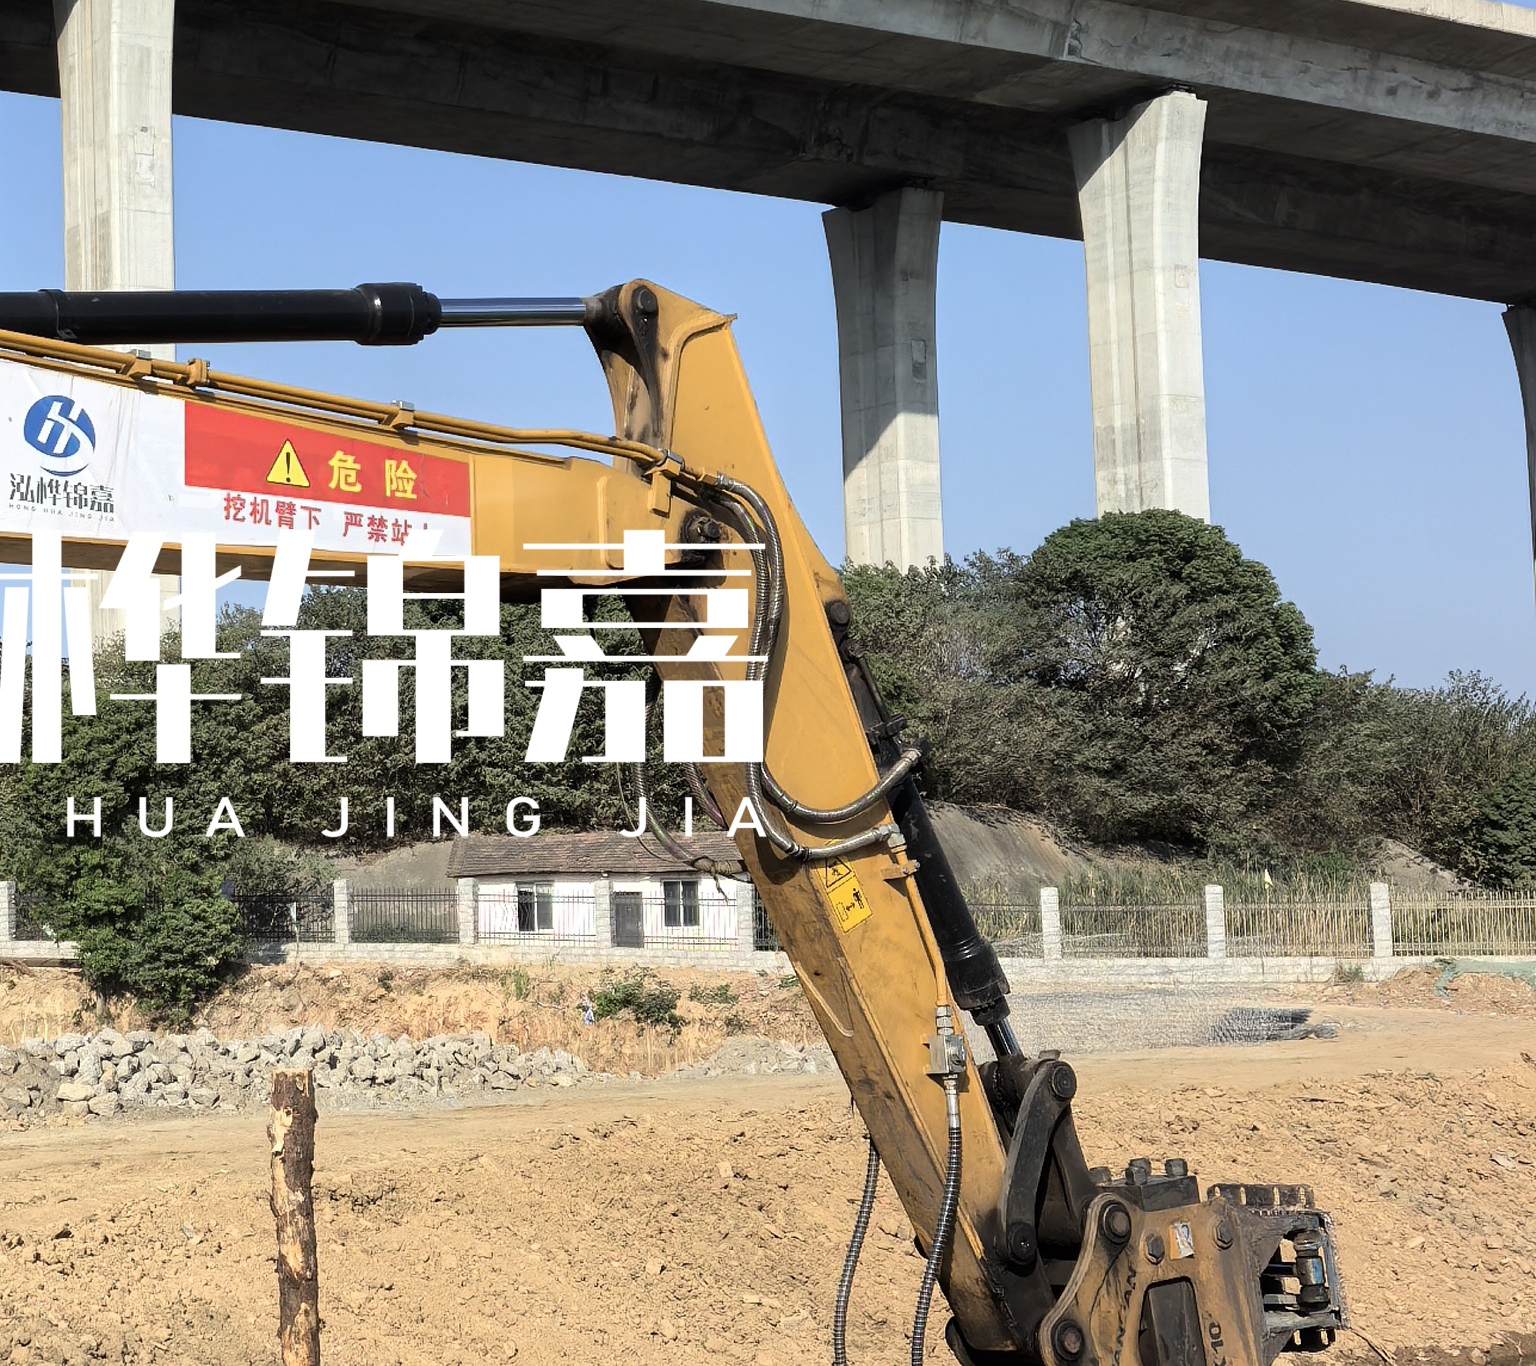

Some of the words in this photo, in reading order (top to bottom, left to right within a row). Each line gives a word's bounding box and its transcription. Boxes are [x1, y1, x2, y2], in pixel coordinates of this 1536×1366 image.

[9, 472, 115, 514] 泓桦锦嘉
[327, 449, 419, 500] 危险
[9, 502, 37, 512] HONG
[223, 492, 322, 530] 挖机臂下
[342, 510, 430, 547] 严禁站
